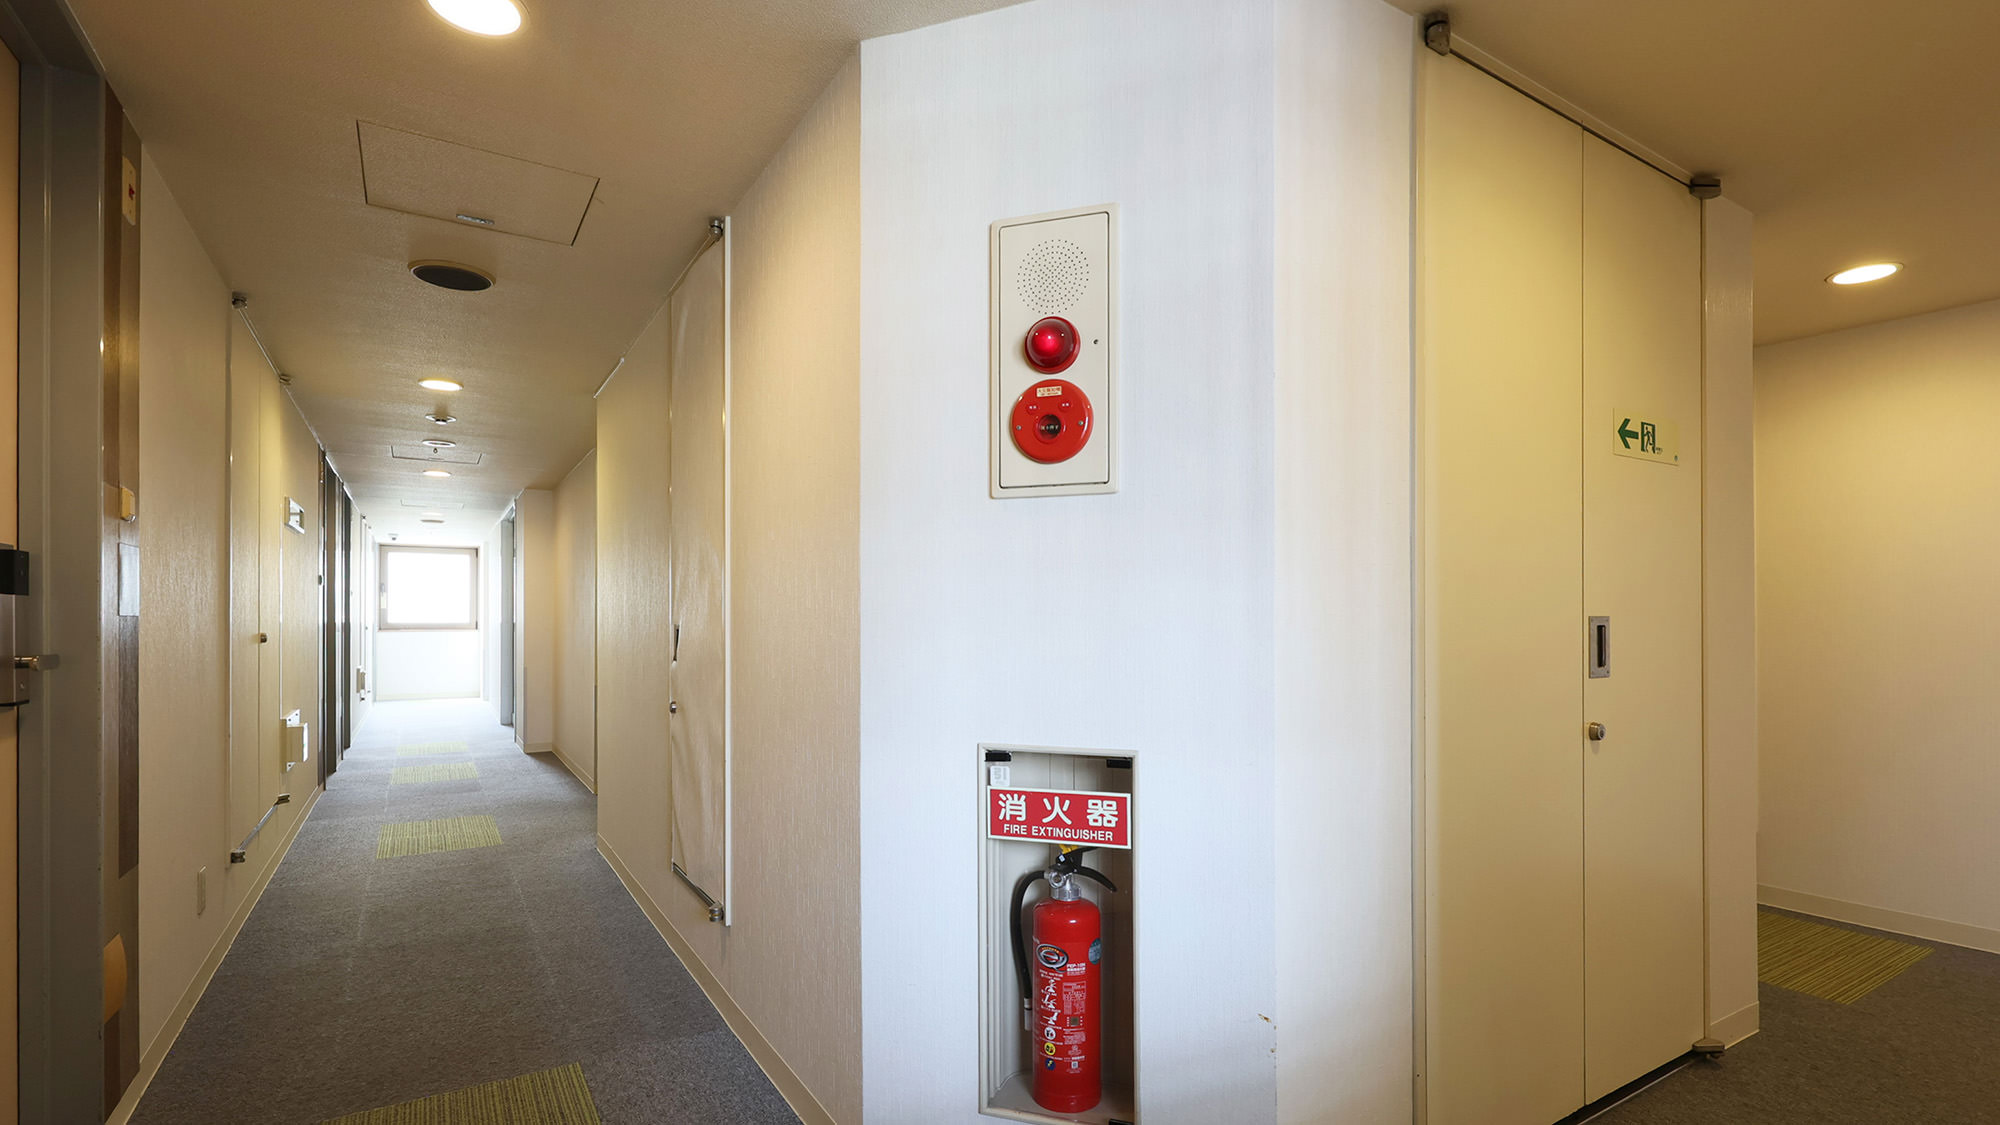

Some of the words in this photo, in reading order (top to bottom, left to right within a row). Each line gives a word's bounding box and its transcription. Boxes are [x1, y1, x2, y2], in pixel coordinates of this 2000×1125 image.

[998, 793, 1119, 828] 消火器
[1003, 823, 1028, 835] FIRE
[1031, 826, 1113, 841] EXTINGUISHER
